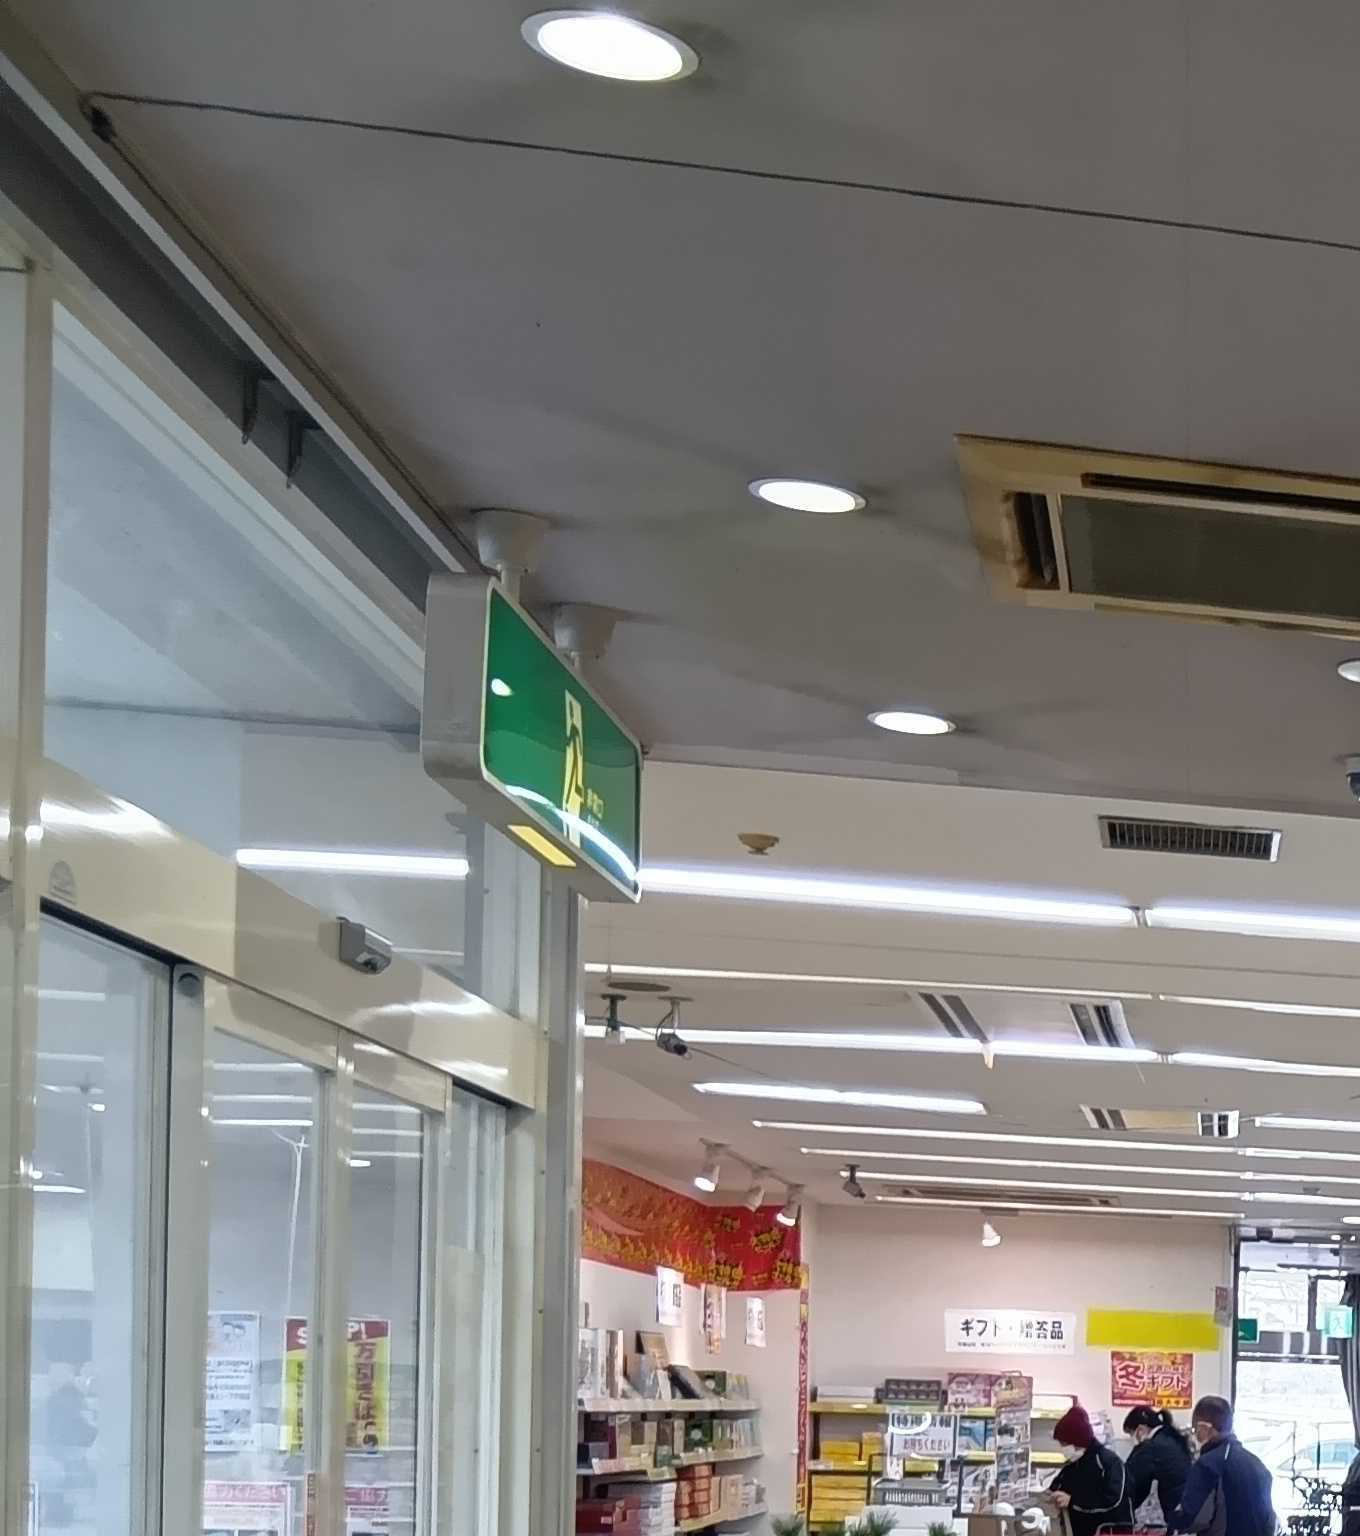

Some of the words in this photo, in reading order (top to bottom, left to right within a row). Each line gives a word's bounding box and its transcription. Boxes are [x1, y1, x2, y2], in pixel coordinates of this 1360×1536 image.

[1116, 1362, 1145, 1391] 冬
[1146, 1374, 1188, 1391] ギフト
